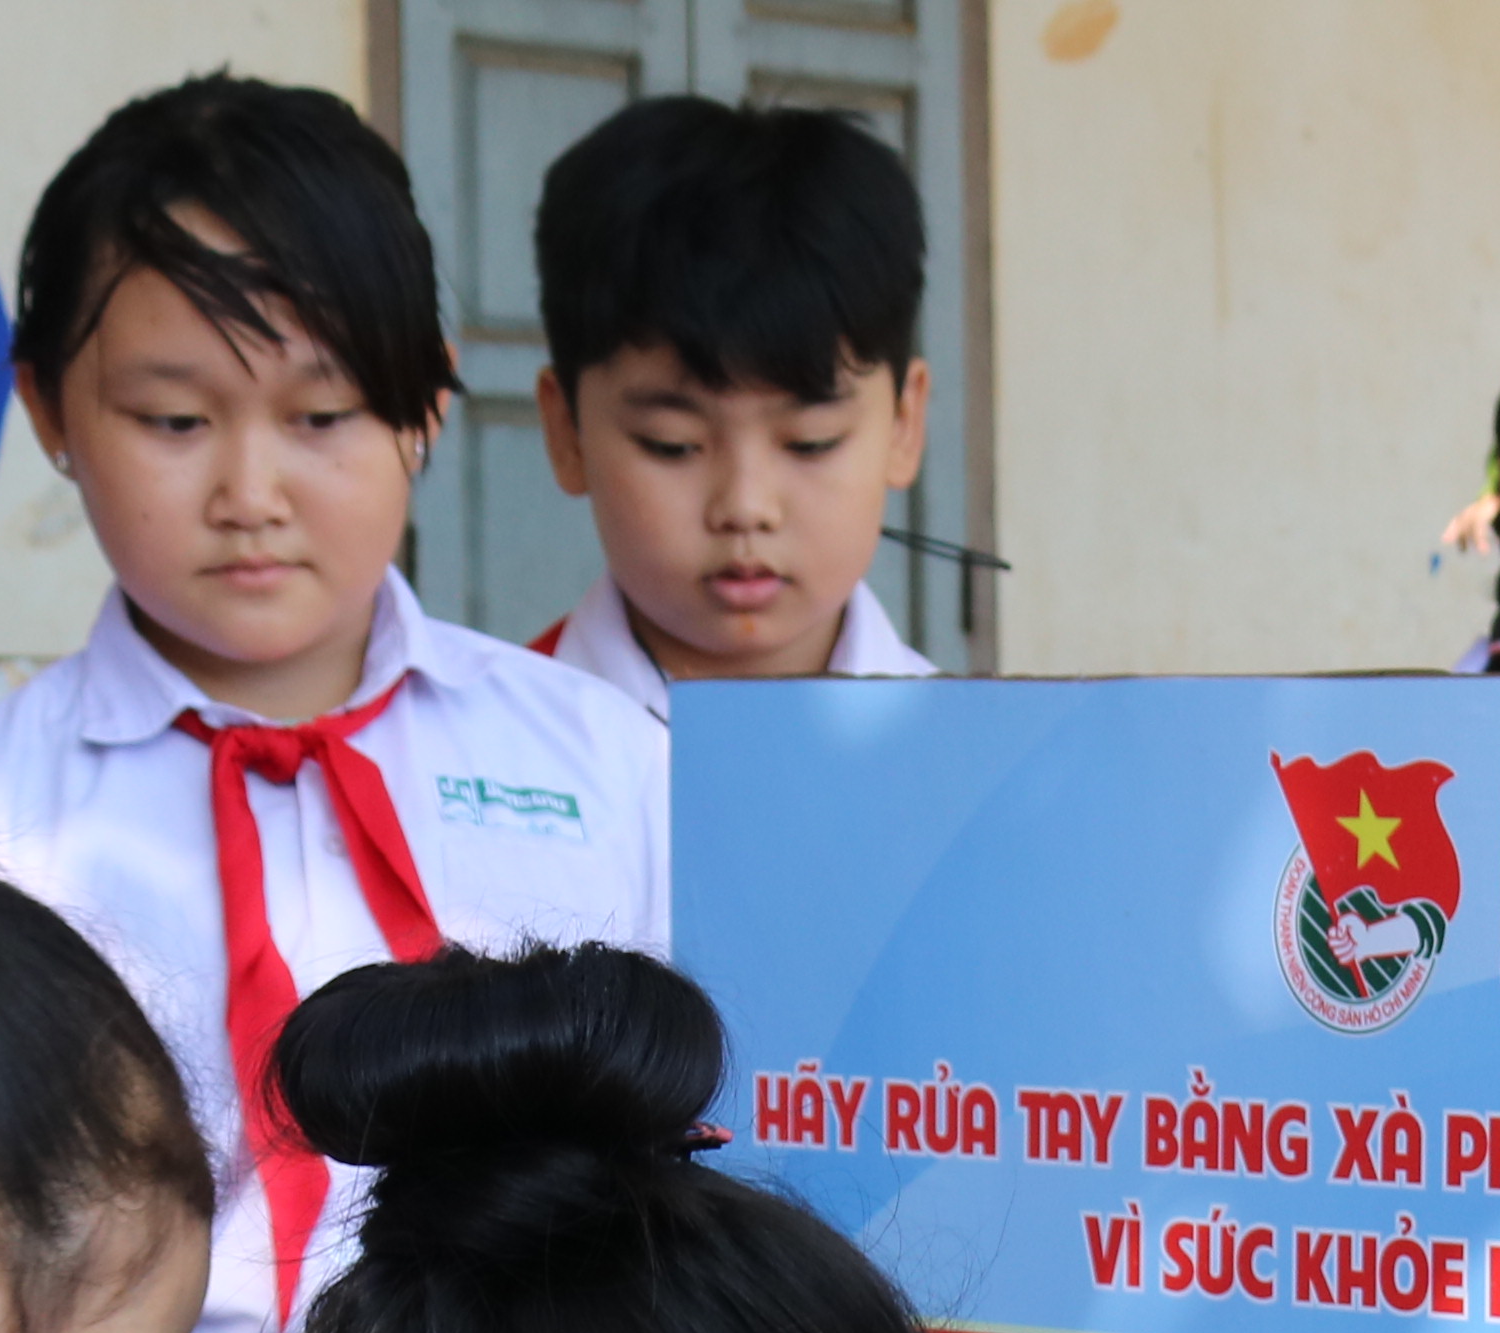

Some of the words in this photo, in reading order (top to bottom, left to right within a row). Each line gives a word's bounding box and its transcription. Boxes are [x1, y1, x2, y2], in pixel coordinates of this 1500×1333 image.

[757, 1064, 866, 1147] HÃY
[886, 1064, 998, 1157] RỬA
[1018, 1089, 1124, 1164] TAY
[1145, 1070, 1310, 1178] BẰNG
[1334, 1094, 1424, 1185] XÀ
[1085, 1202, 1142, 1288] VÌ
[1162, 1208, 1274, 1300] SỨC
[1296, 1215, 1467, 1316] KHỎE
